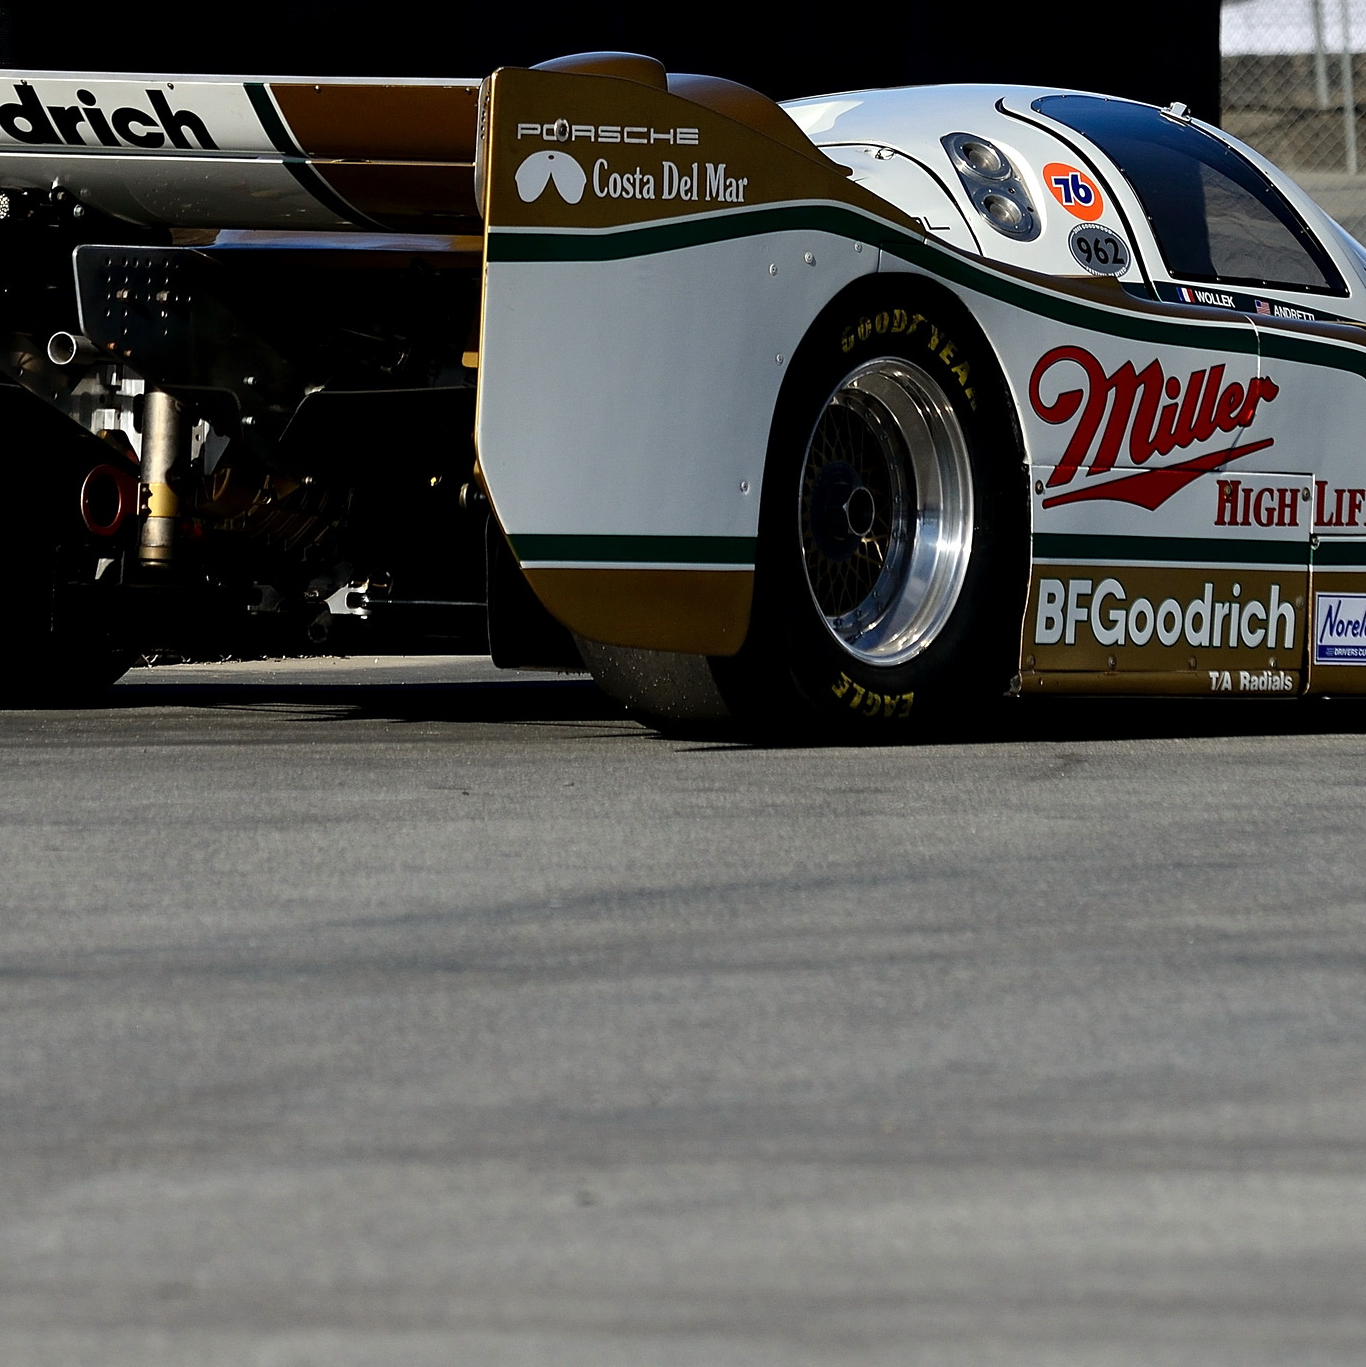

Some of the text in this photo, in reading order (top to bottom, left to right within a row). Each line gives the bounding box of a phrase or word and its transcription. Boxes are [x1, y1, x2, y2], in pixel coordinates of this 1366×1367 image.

[592, 158, 748, 203] Costa Del Mar
[1052, 172, 1095, 206] 76
[1077, 237, 1125, 265] 962
[1194, 290, 1235, 308] WOLLEK
[1273, 305, 1315, 321] ANDRETTI
[1028, 345, 1280, 488] Miller
[1214, 479, 1300, 527] HIGH
[1035, 577, 1296, 649] BFGoodrich
[1334, 647, 1358, 656] DRIVERS
[831, 670, 915, 719] EAGLE
[1208, 671, 1293, 692] T/A Radials
